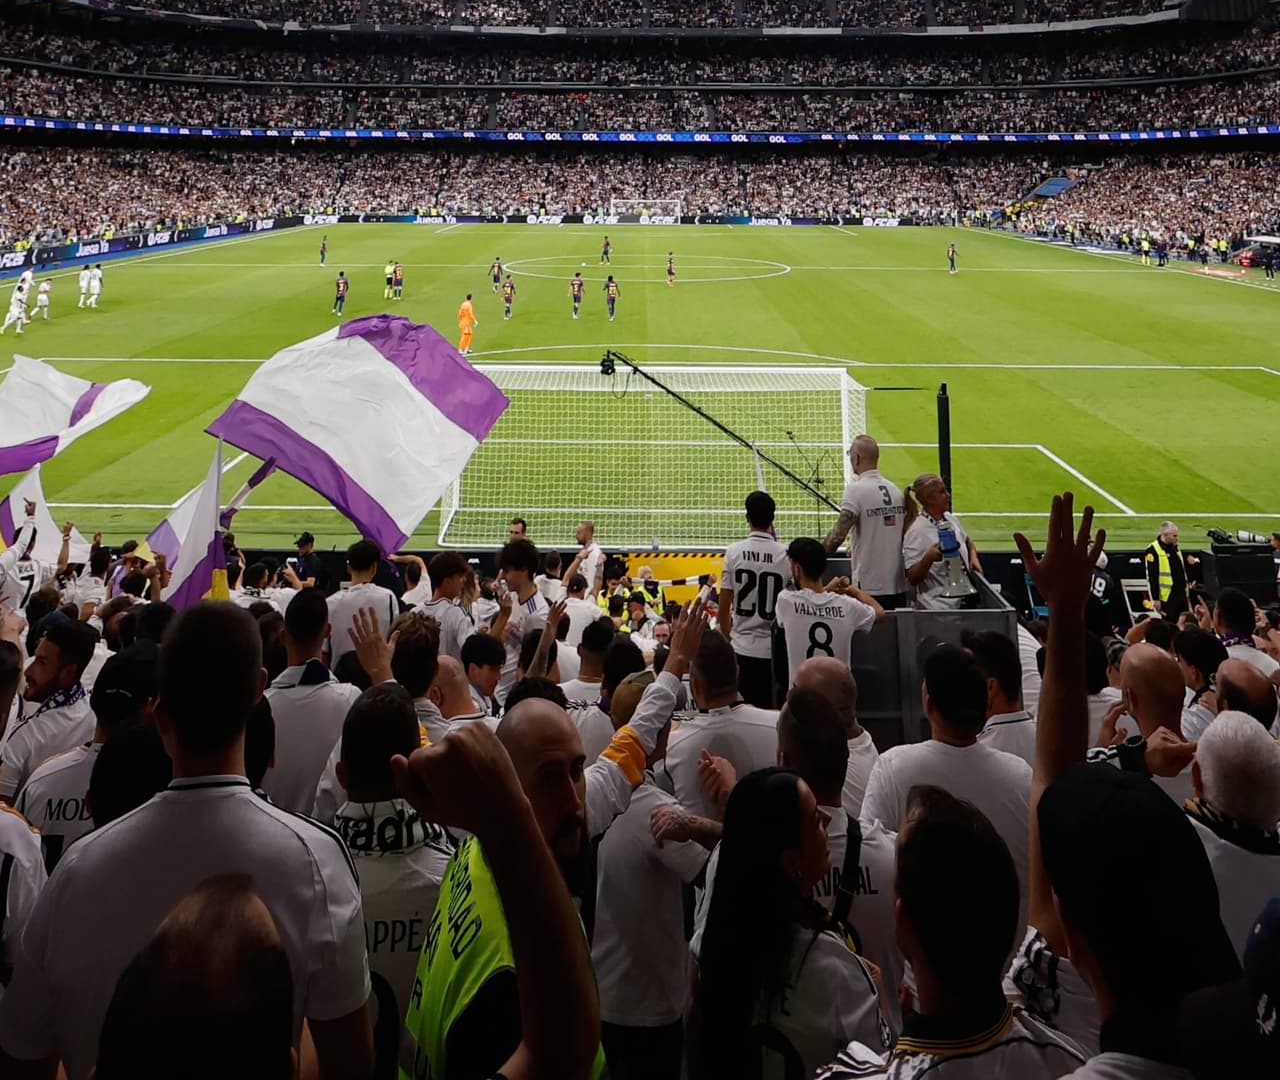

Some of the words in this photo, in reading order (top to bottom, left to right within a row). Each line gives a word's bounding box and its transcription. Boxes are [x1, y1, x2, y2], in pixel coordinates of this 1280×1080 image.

[508, 132, 524, 141] GOL
[545, 132, 563, 141] GOL
[582, 133, 600, 141] GOL
[620, 133, 636, 141] GOL
[657, 133, 674, 142] GOL
[694, 133, 712, 142] GOL
[731, 134, 748, 142] GOL
[770, 135, 786, 143] GOL
[878, 485, 892, 506] 3
[741, 551, 762, 563] VINI
[762, 552, 773, 564] JR
[19, 574, 35, 609] 7
[734, 569, 783, 622] 20
[793, 602, 845, 619] VALVERDE
[806, 621, 835, 661] 8
[43, 797, 94, 822] MOD
[372, 911, 424, 953] PPÉ
